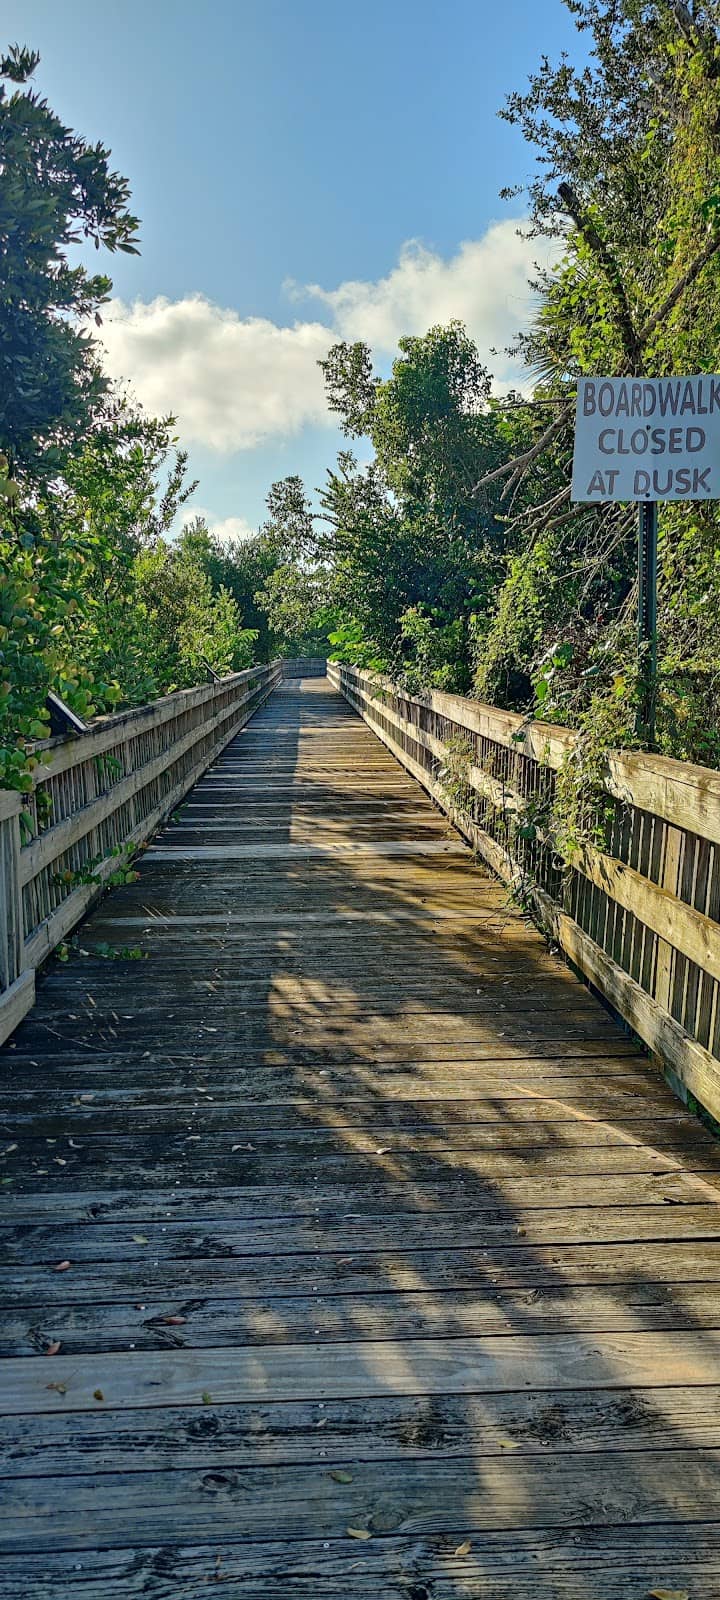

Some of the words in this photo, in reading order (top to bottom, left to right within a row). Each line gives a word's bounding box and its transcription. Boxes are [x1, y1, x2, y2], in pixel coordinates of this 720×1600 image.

[583, 379, 720, 417] BOARDWALK
[598, 427, 706, 455] CLOSED
[586, 470, 620, 496] AT
[633, 467, 712, 496] DUSK
